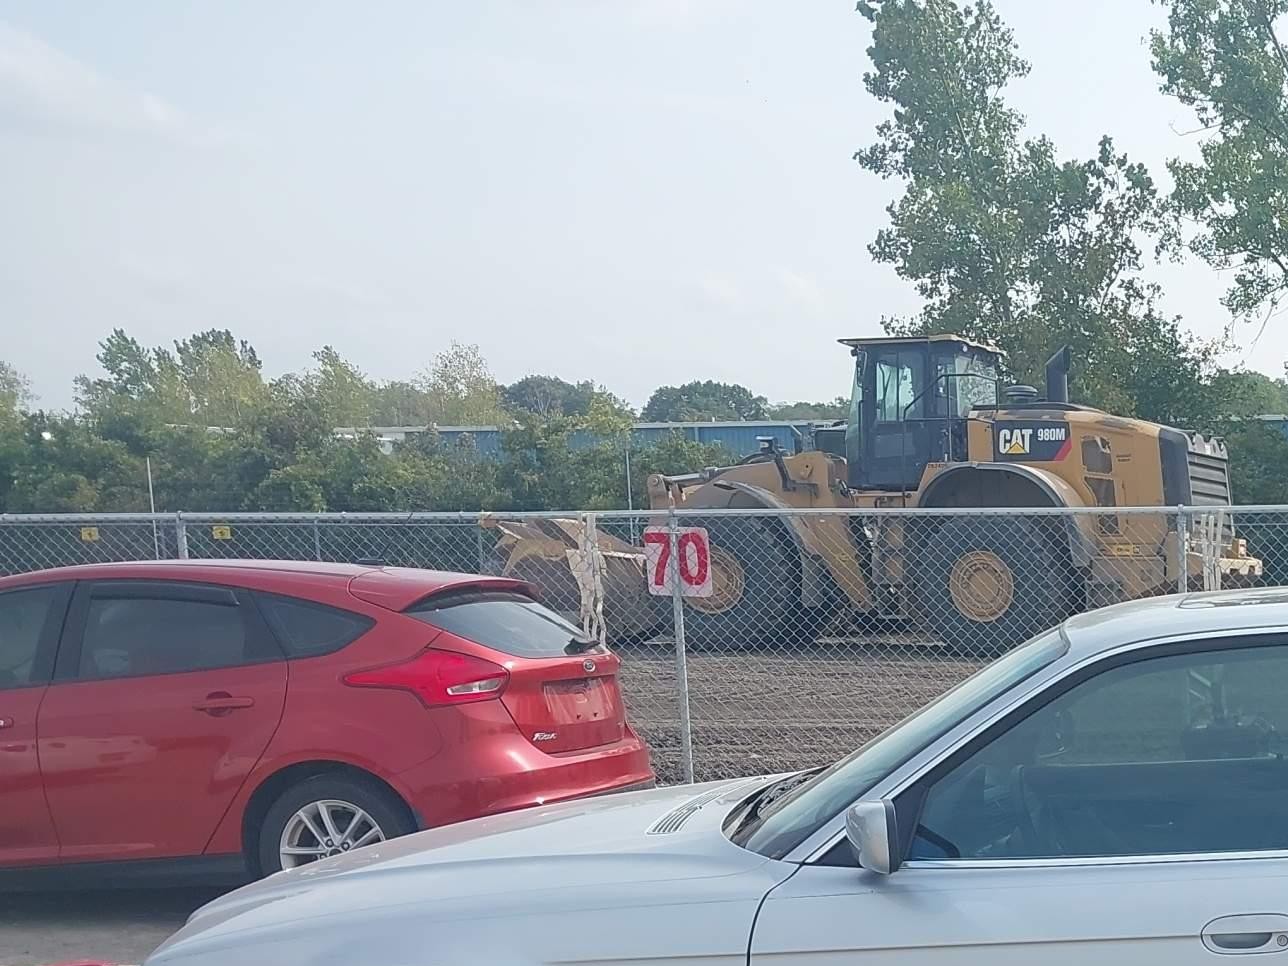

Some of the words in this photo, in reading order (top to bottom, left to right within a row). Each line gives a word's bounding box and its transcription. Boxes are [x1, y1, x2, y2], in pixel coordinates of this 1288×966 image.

[999, 428, 1033, 454] CAT
[1037, 428, 1066, 441] 980M
[644, 532, 708, 586] 70
